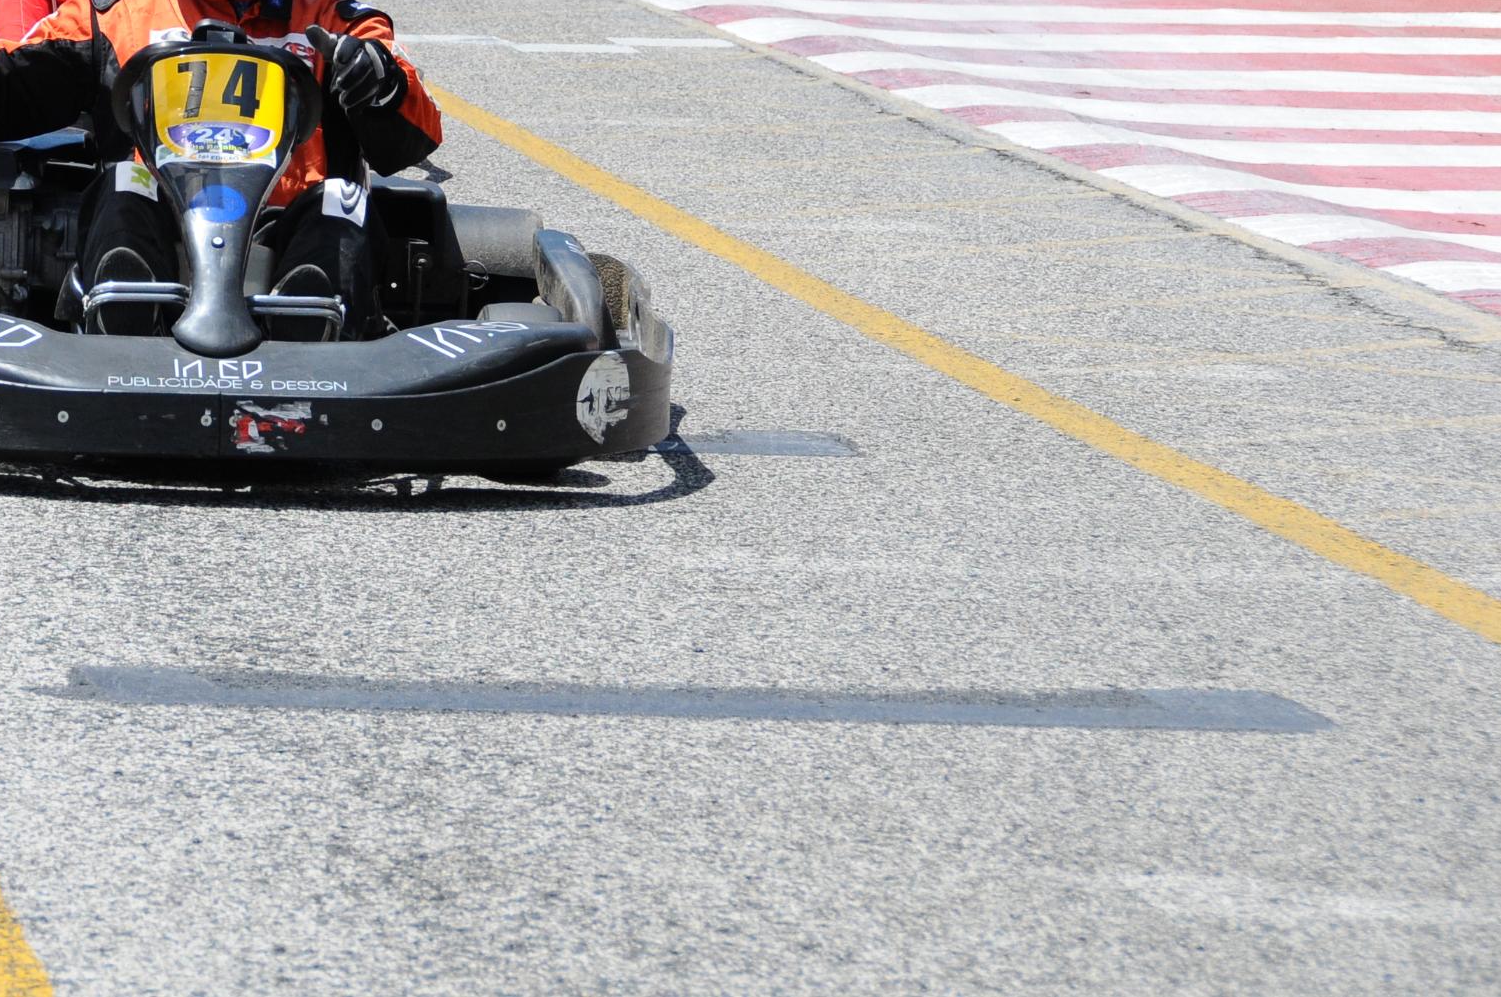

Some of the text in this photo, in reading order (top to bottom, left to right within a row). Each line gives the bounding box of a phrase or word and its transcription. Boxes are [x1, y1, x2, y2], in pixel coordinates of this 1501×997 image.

[177, 59, 261, 120] 74
[195, 128, 234, 144] 24
[107, 376, 348, 392] PUBLICIDADE & DESIGN
